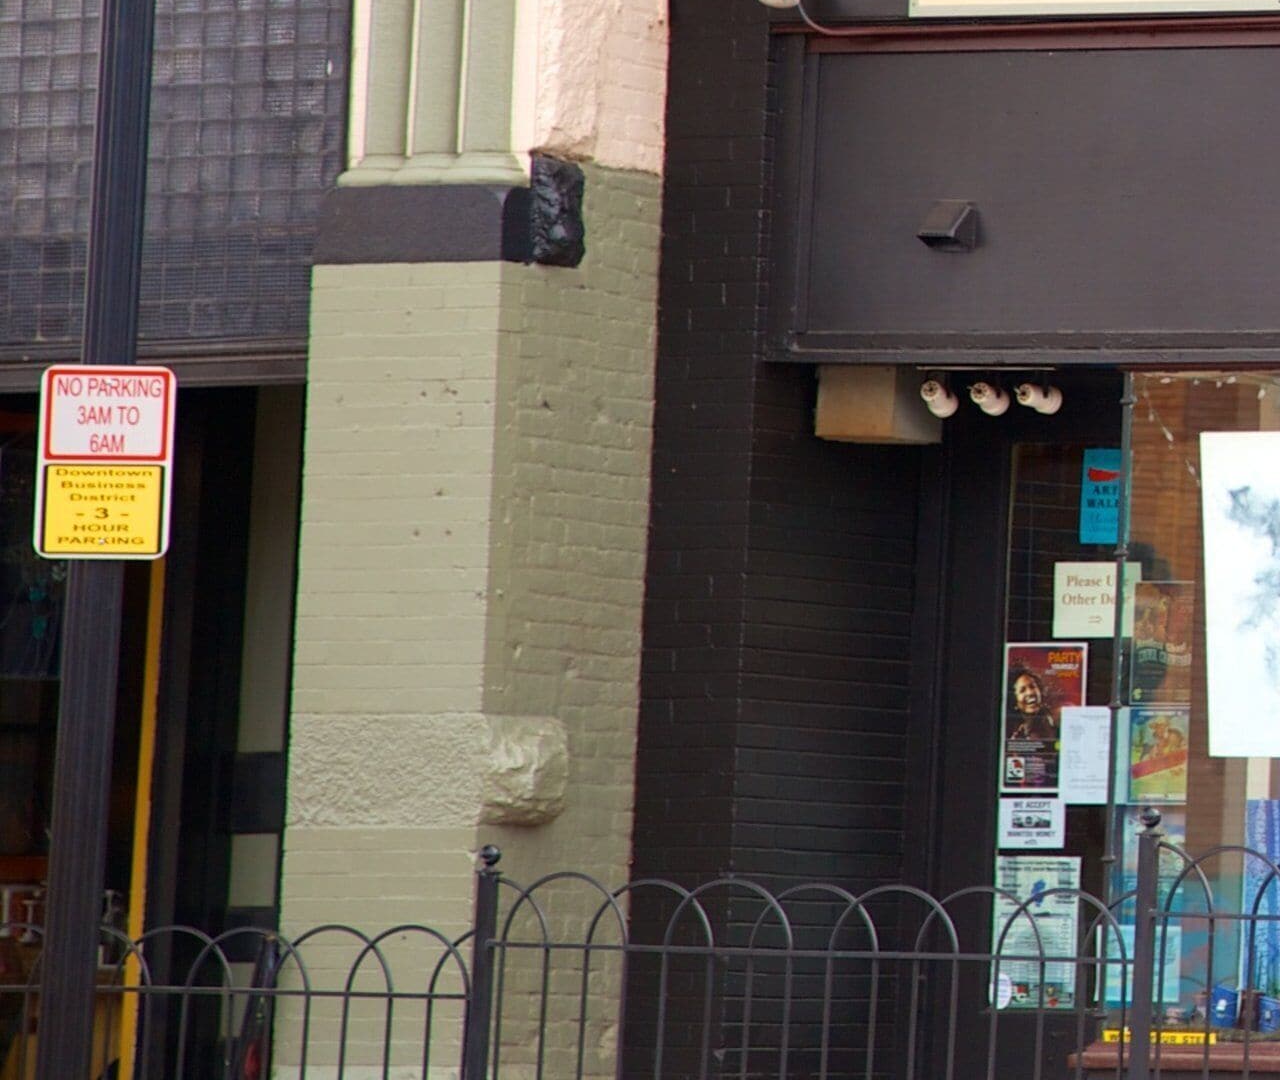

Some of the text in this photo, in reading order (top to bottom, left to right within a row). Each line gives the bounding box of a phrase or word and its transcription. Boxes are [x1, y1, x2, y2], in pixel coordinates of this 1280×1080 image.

[57, 377, 163, 398] NO PARKING
[77, 406, 140, 425] 3AM TO
[89, 434, 125, 453] 6AM
[56, 468, 153, 477] Downtown
[61, 481, 146, 489] Business
[69, 493, 136, 502] District
[72, 523, 129, 532] HOUR
[1066, 575, 1101, 587] Please
[1062, 593, 1131, 606] Other Dor
[1048, 652, 1082, 663] PARTY
